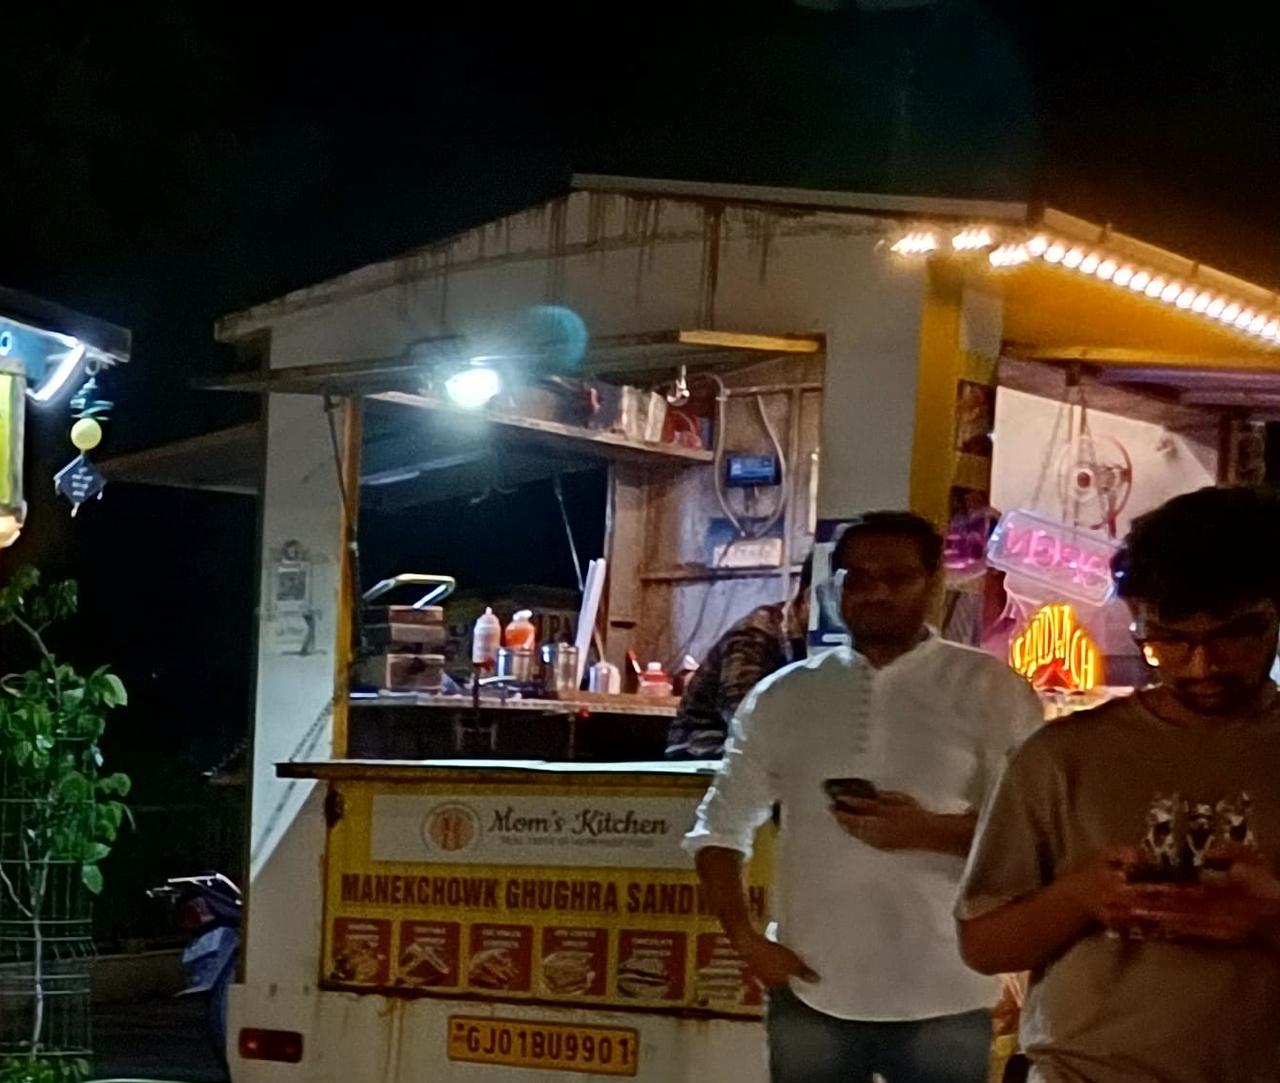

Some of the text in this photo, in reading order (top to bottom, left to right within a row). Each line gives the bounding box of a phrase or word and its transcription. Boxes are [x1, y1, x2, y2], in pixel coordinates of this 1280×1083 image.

[487, 806, 671, 837] Mom's Kitchen
[341, 872, 499, 909] MANEKCHOWK
[504, 878, 620, 914] GHUGHRA
